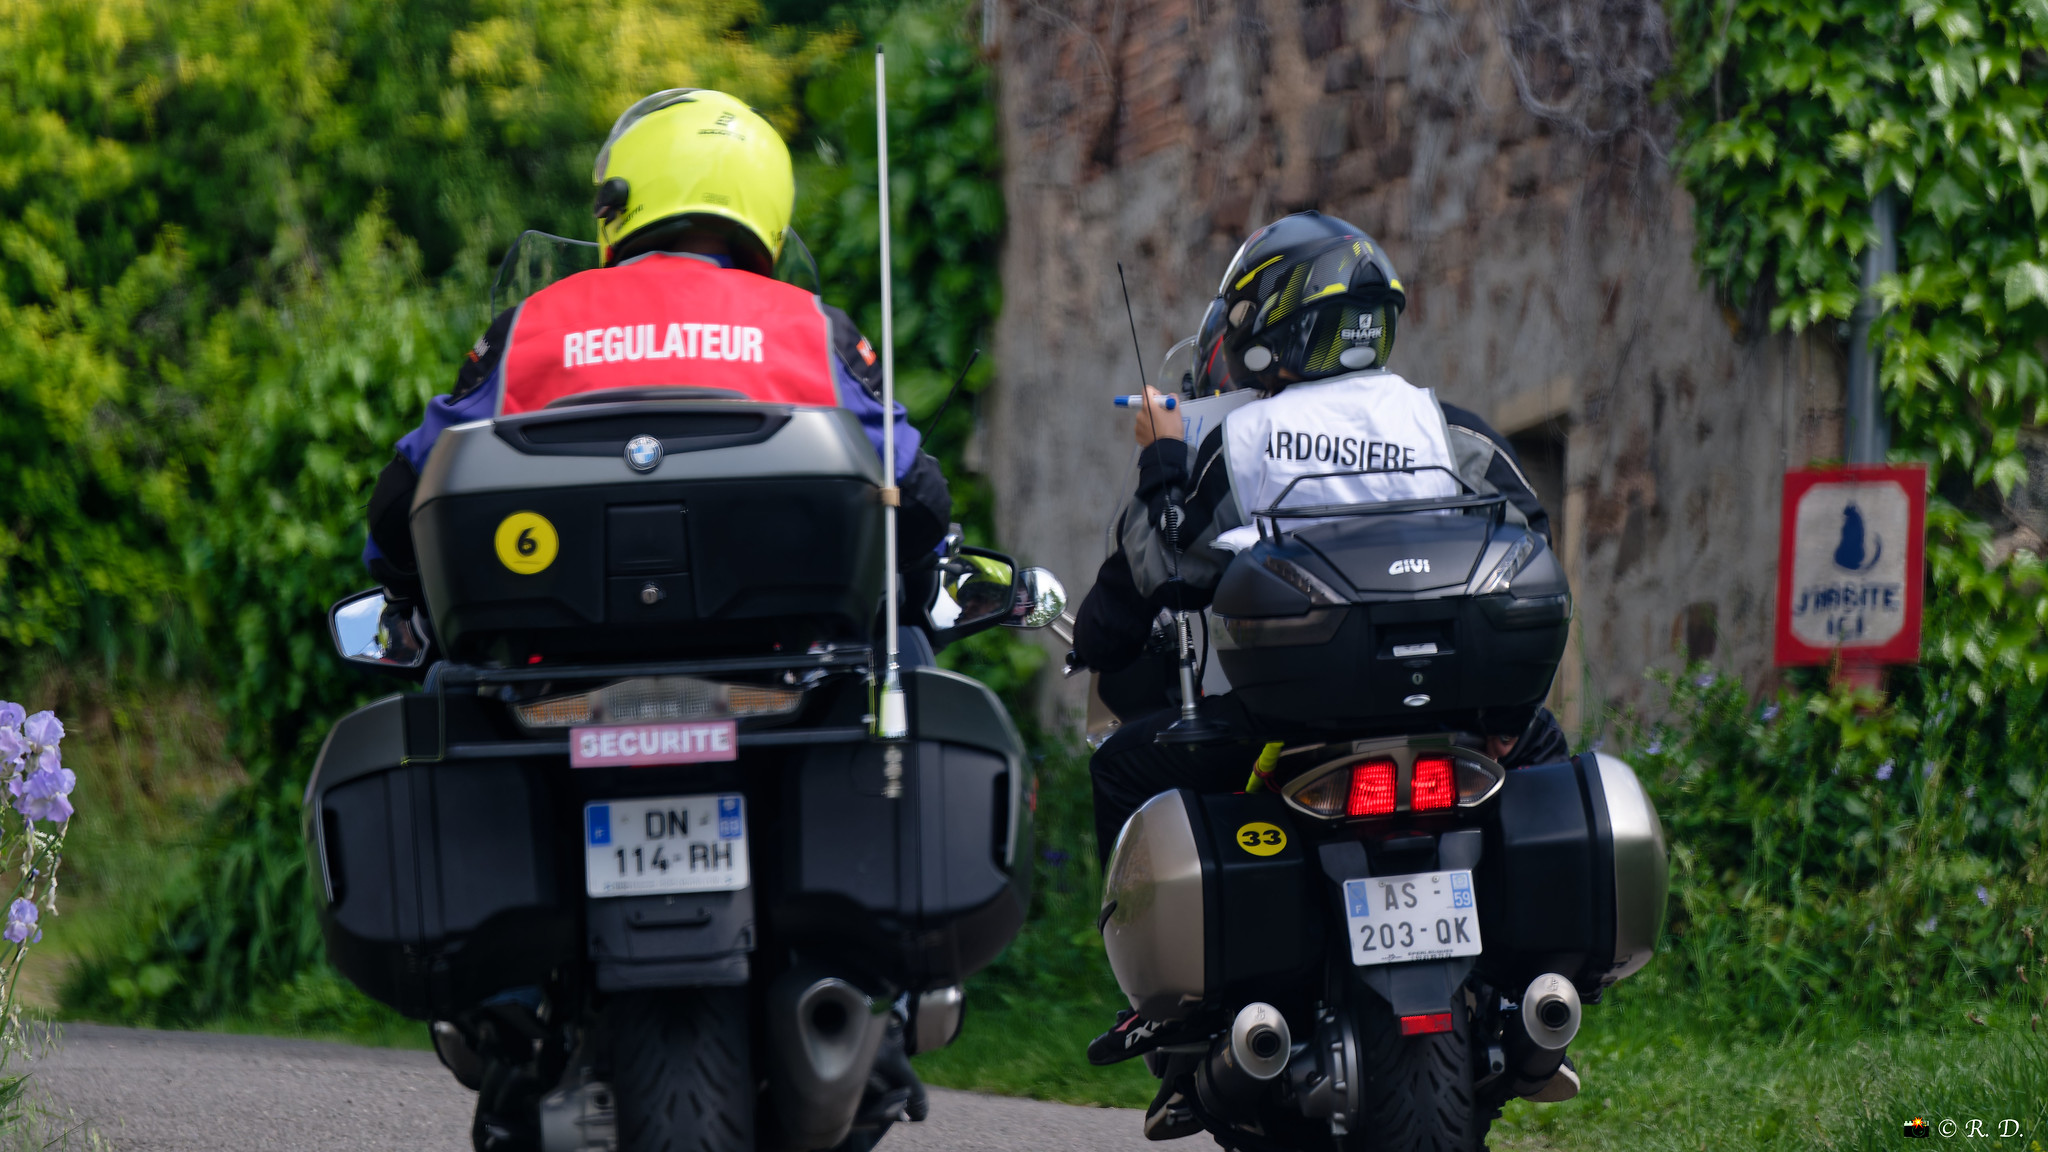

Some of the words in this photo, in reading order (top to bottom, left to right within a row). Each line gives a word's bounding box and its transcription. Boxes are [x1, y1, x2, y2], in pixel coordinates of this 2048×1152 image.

[1341, 327, 1383, 340] SHARK
[563, 323, 764, 368] REGULATEUR
[516, 527, 538, 557] 6
[1388, 558, 1431, 575] GIVI
[580, 724, 731, 759] SECURITE
[645, 809, 689, 840] DN
[1242, 829, 1282, 847] 33
[1384, 882, 1418, 911] AS
[1453, 891, 1472, 907] 59
[1355, 904, 1362, 914] F
